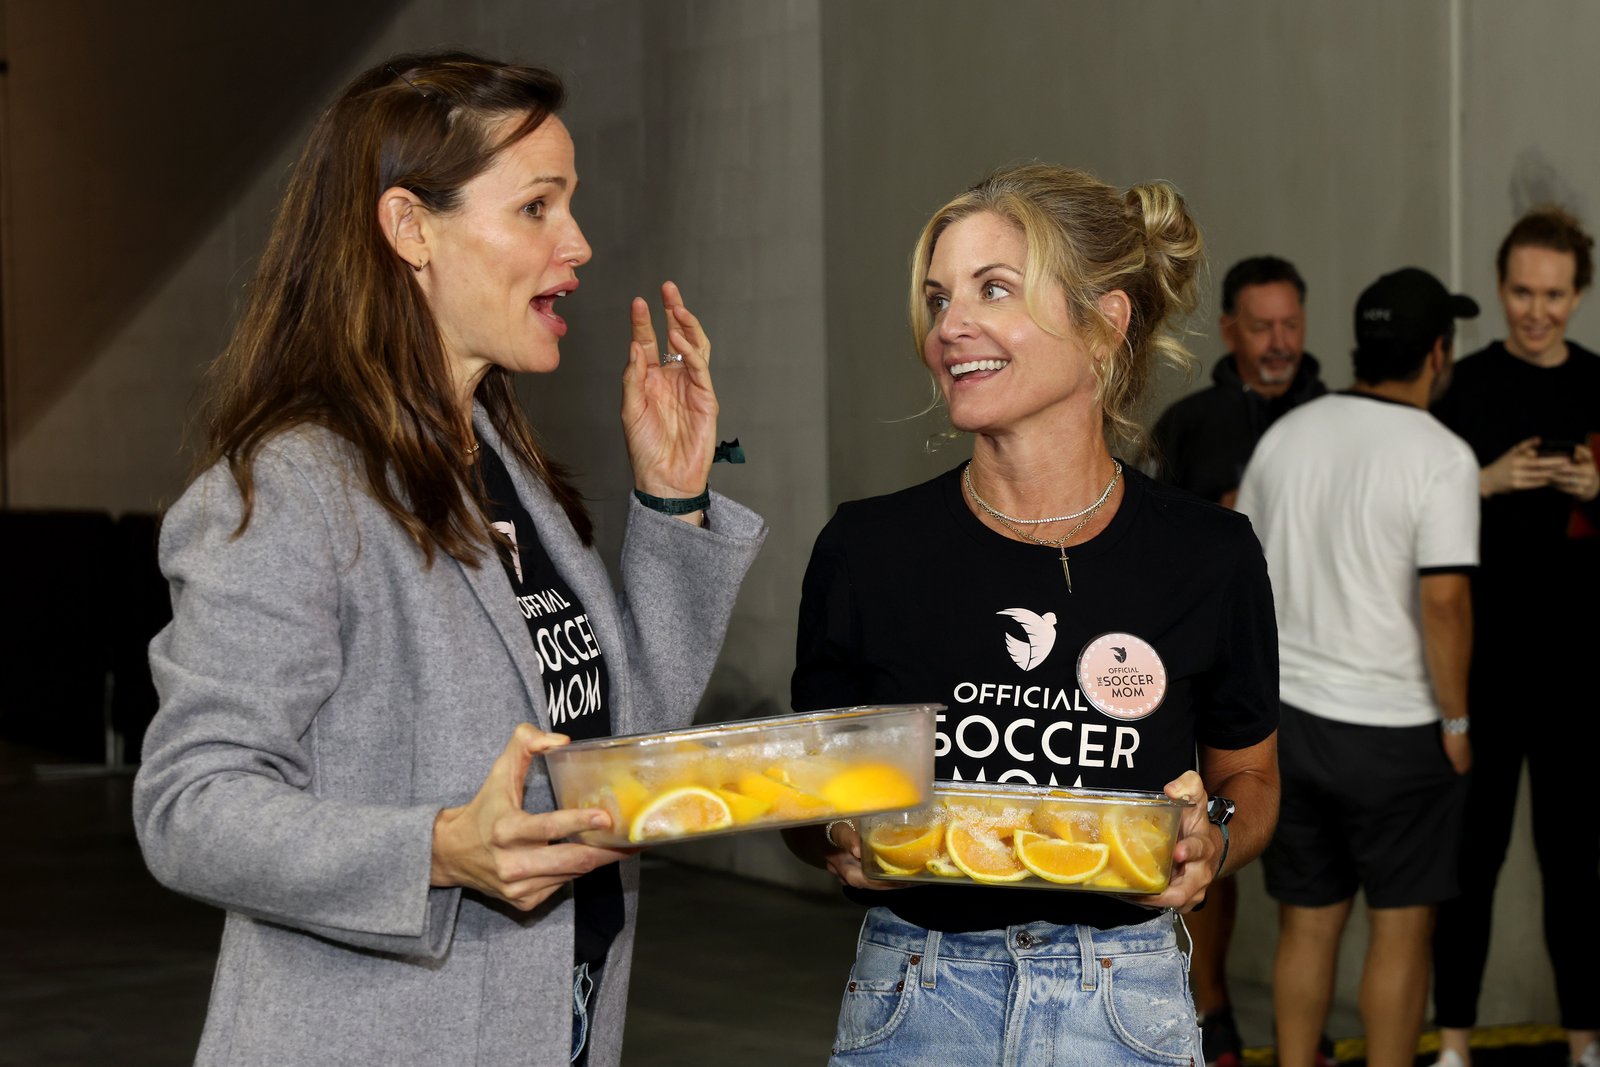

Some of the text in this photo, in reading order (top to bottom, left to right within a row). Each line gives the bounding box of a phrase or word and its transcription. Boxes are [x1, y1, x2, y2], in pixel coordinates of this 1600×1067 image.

[516, 588, 571, 619] OFFIIAL
[535, 613, 602, 675] OCCE
[1102, 674, 1154, 687] SOCCER
[1108, 666, 1139, 674] OFFICIAL
[547, 666, 602, 727] MOM
[953, 682, 1089, 712] OFFICIAL
[1111, 687, 1145, 698] MOM
